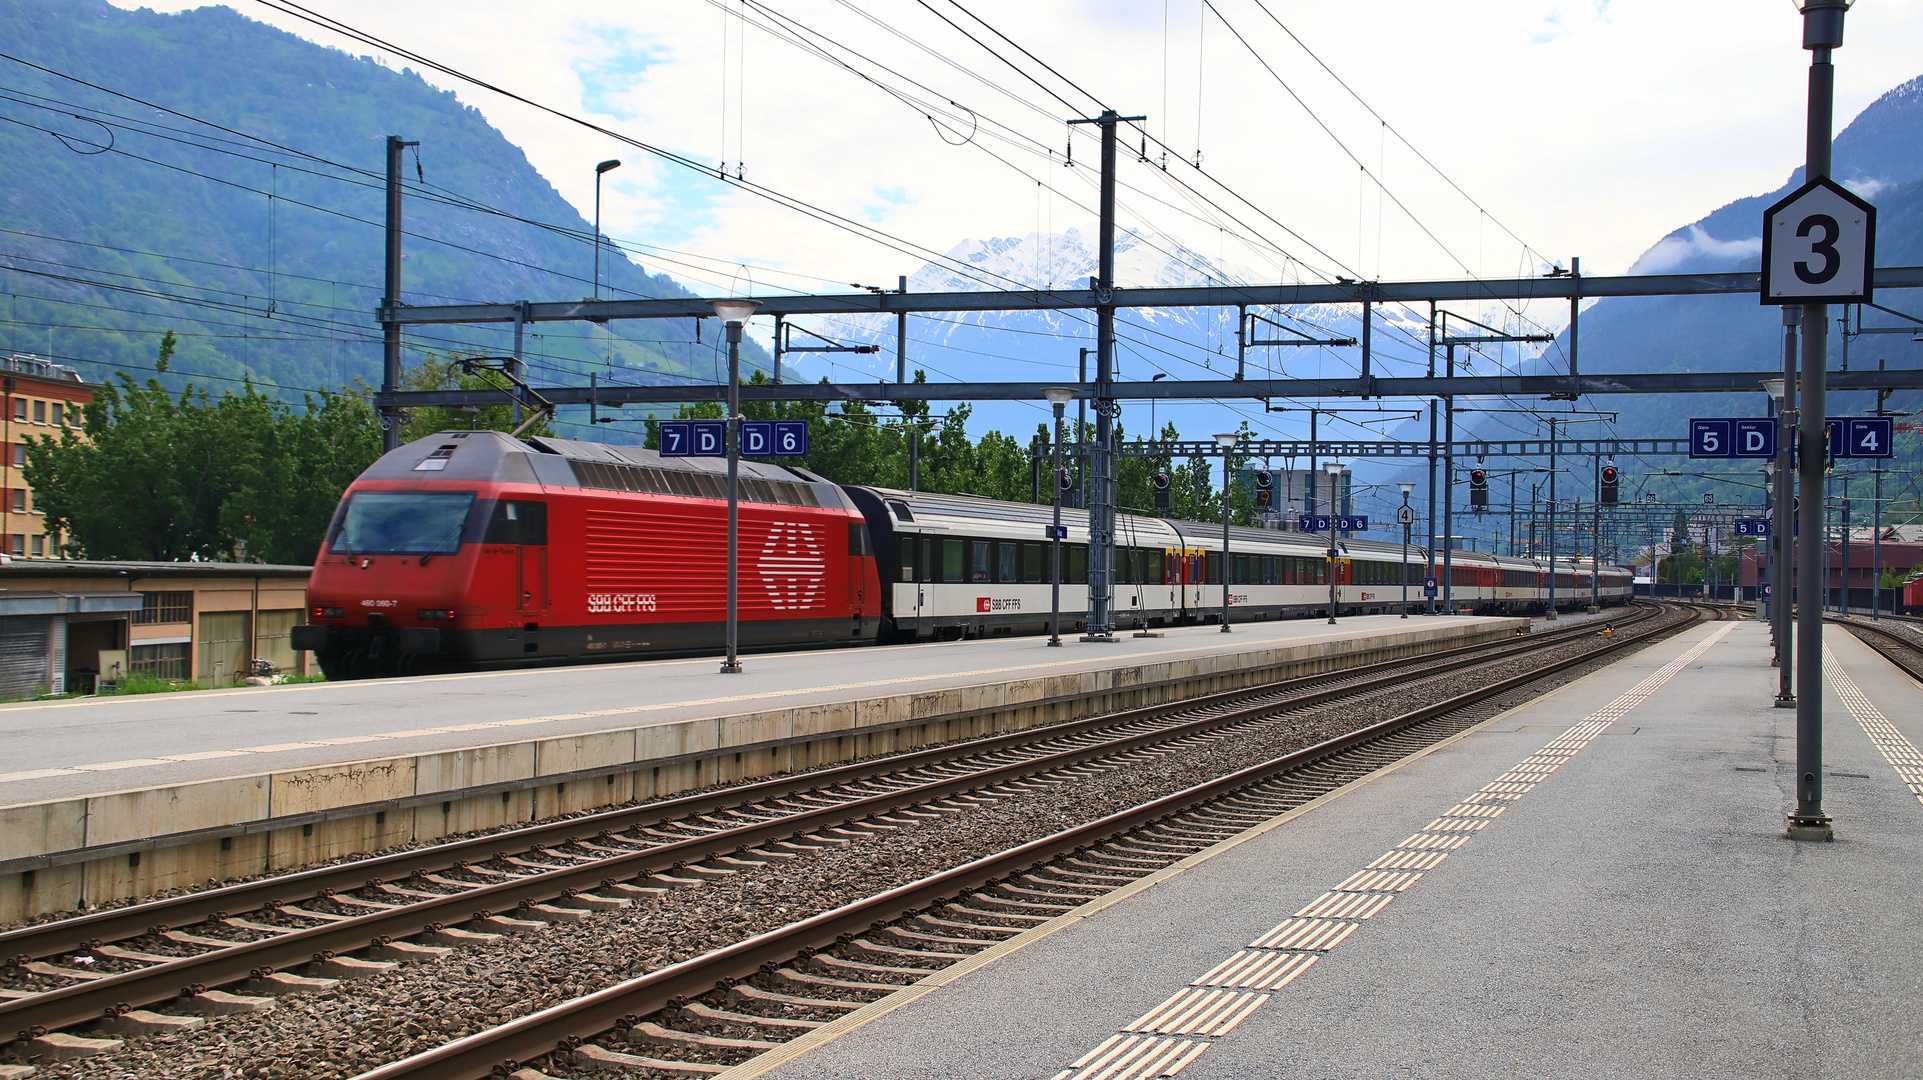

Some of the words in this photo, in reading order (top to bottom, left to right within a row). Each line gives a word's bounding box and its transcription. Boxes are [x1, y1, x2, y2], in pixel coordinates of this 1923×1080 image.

[1794, 214, 1840, 284] 3
[668, 433, 680, 451] 7
[701, 433, 715, 451] D
[750, 433, 764, 450] D
[783, 432, 796, 450] 6
[1703, 432, 1719, 452] 5
[1746, 431, 1764, 451] D
[1860, 430, 1878, 450] 4
[1401, 510, 1408, 521] 4
[1740, 524, 1747, 532] 5
[1758, 524, 1765, 532] D
[588, 594, 612, 612] SBB
[614, 594, 636, 612] CFF
[636, 594, 656, 612] FFS
[992, 598, 1002, 610] SBB
[1002, 598, 1011, 610] CFF
[1012, 598, 1021, 610] FFS
